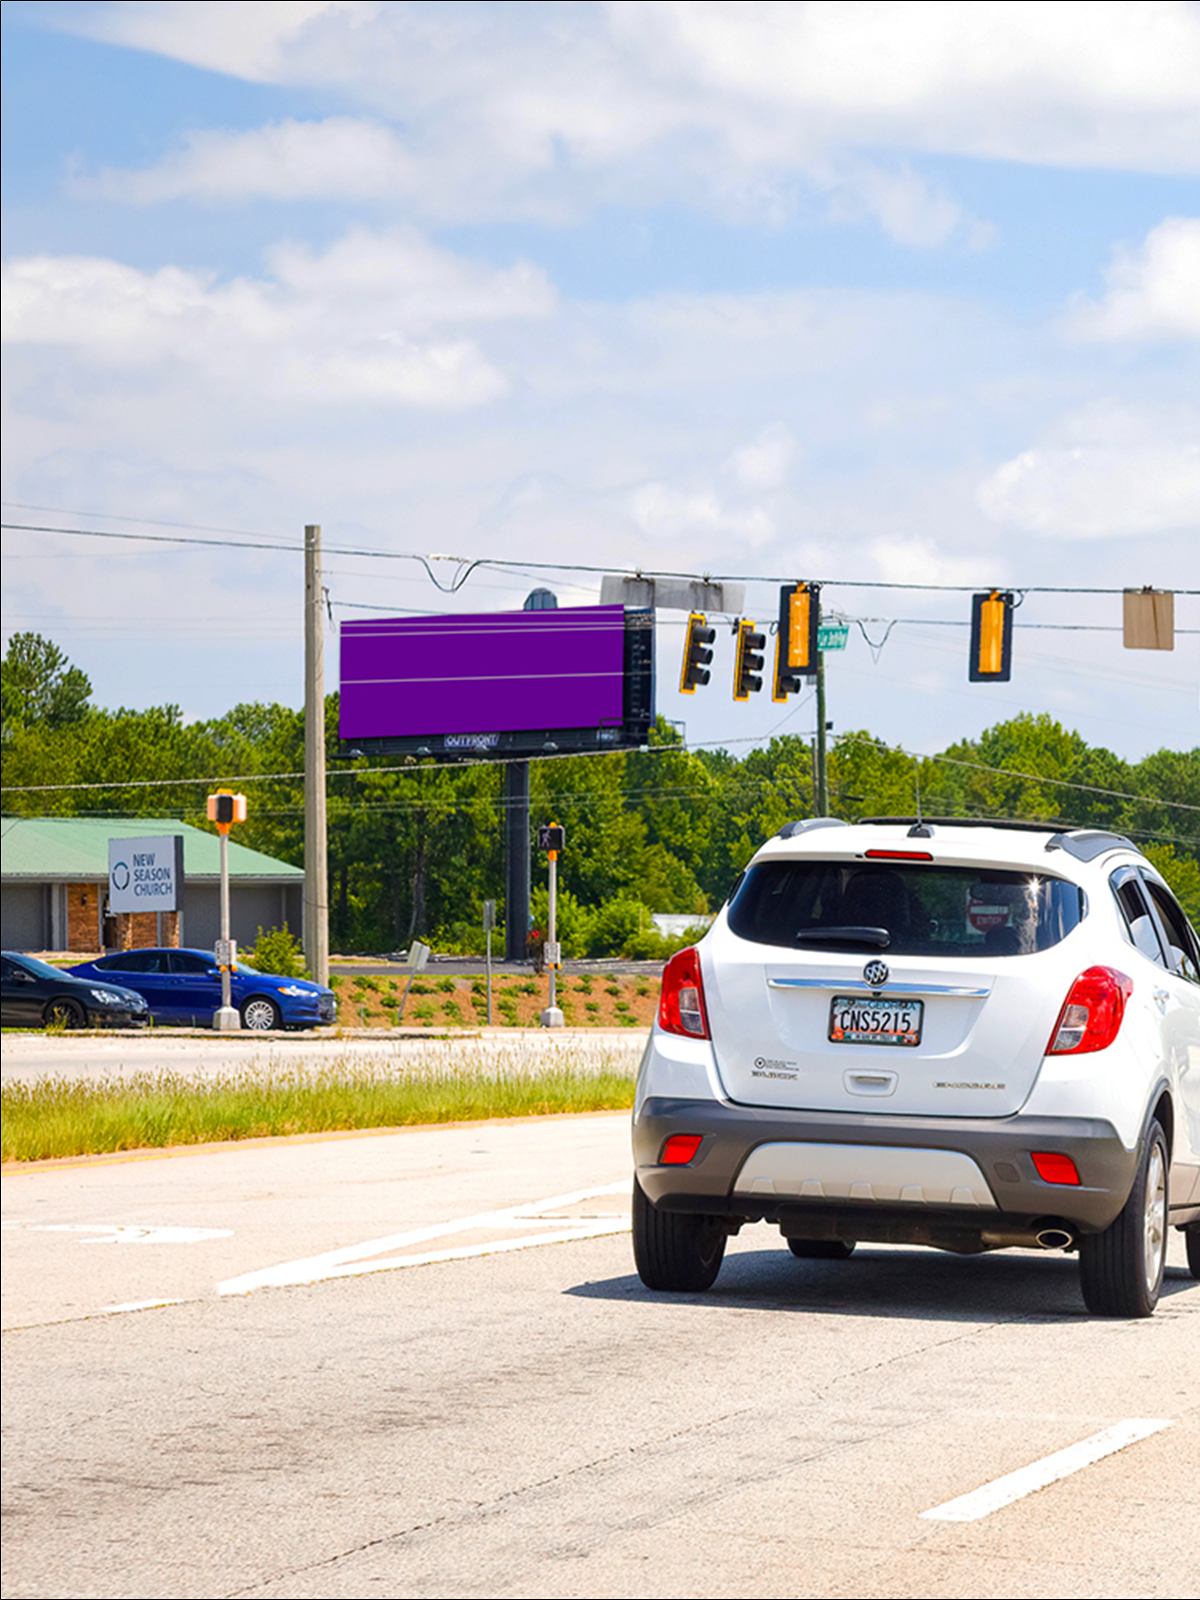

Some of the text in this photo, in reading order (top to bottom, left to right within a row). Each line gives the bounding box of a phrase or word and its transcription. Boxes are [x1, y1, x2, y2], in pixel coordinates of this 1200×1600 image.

[133, 853, 155, 867] NEW
[133, 868, 170, 882] SEASON
[133, 882, 173, 897] CHURCH
[841, 1010, 911, 1033] CNS5215
